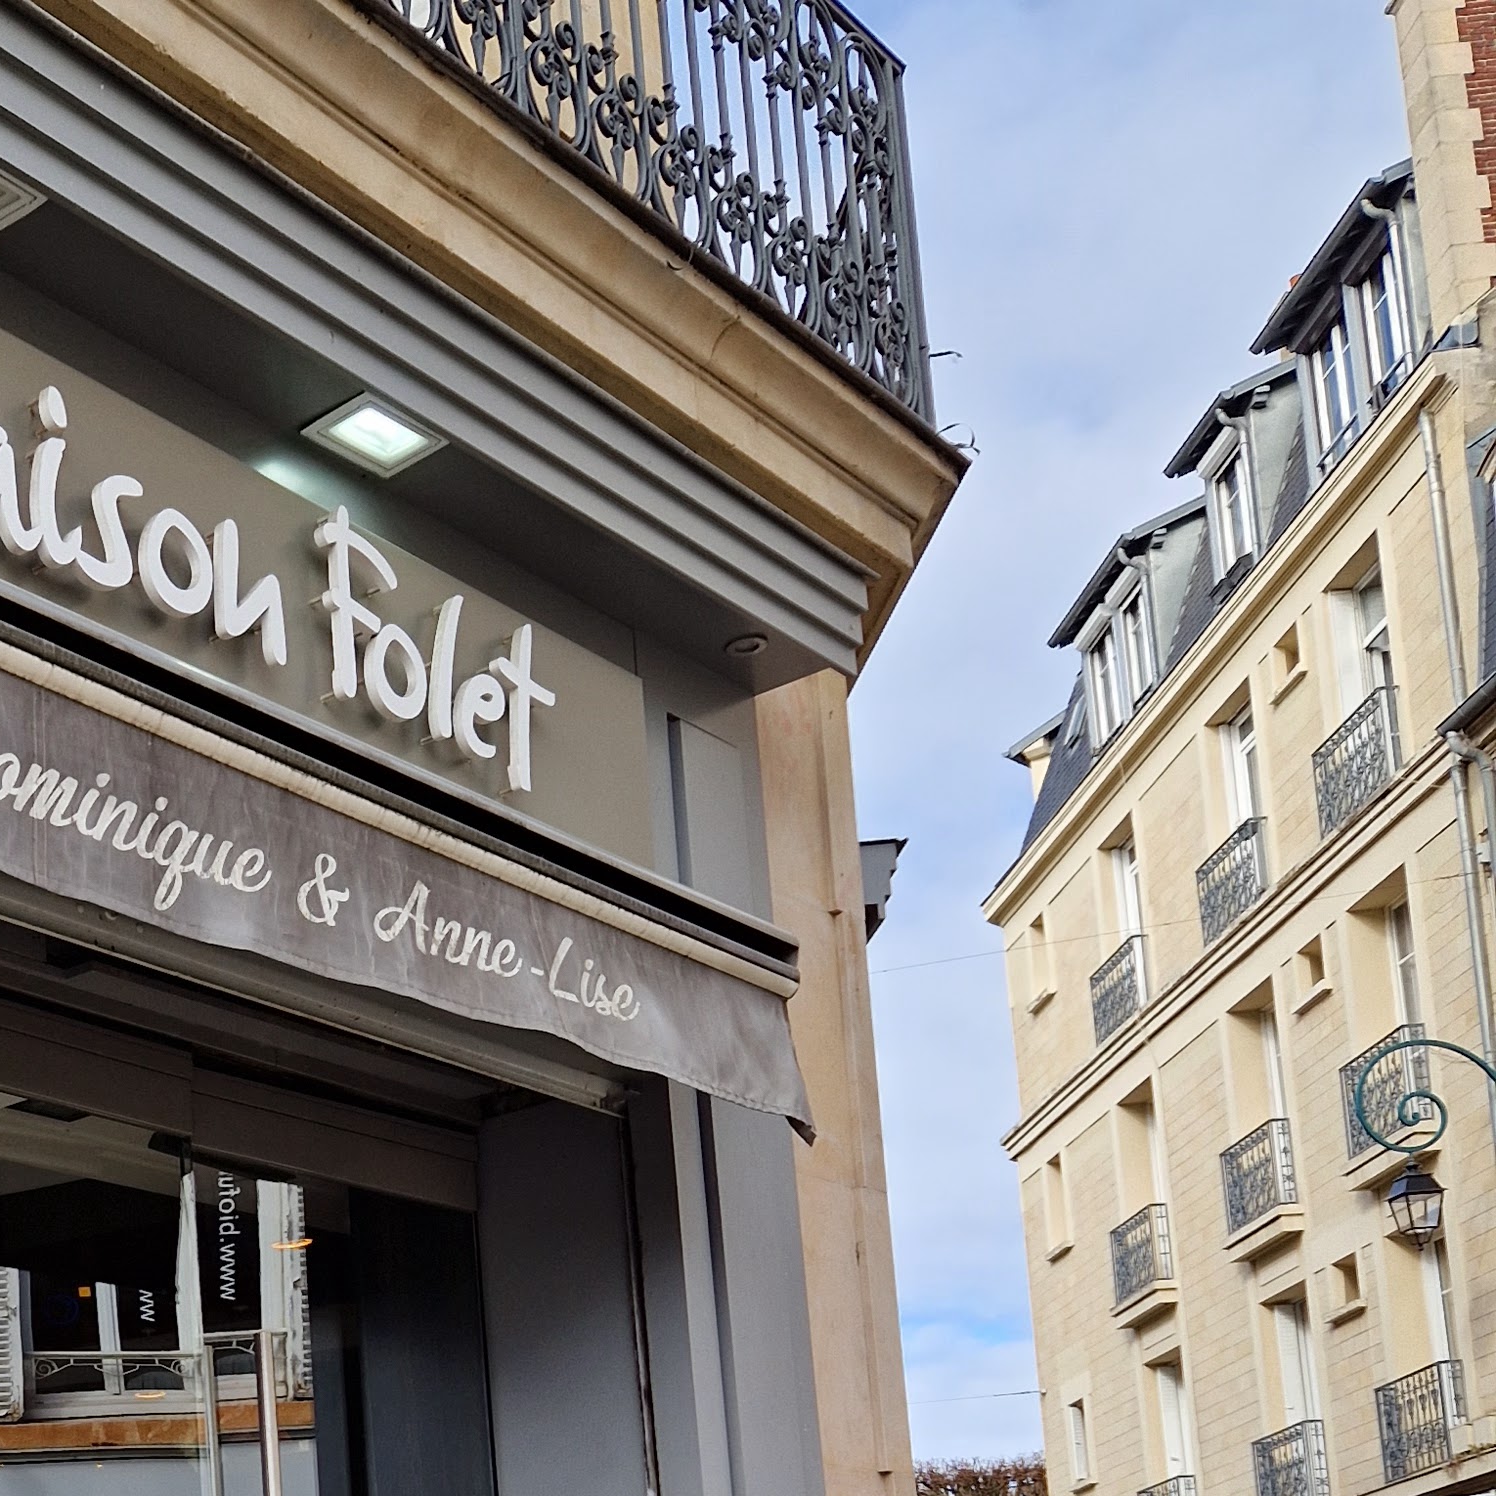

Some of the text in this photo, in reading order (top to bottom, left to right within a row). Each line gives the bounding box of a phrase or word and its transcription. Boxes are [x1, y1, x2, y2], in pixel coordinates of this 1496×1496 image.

[312, 505, 556, 792] Folet
[296, 853, 351, 926] &
[374, 880, 641, 1022] Anne-Lise
